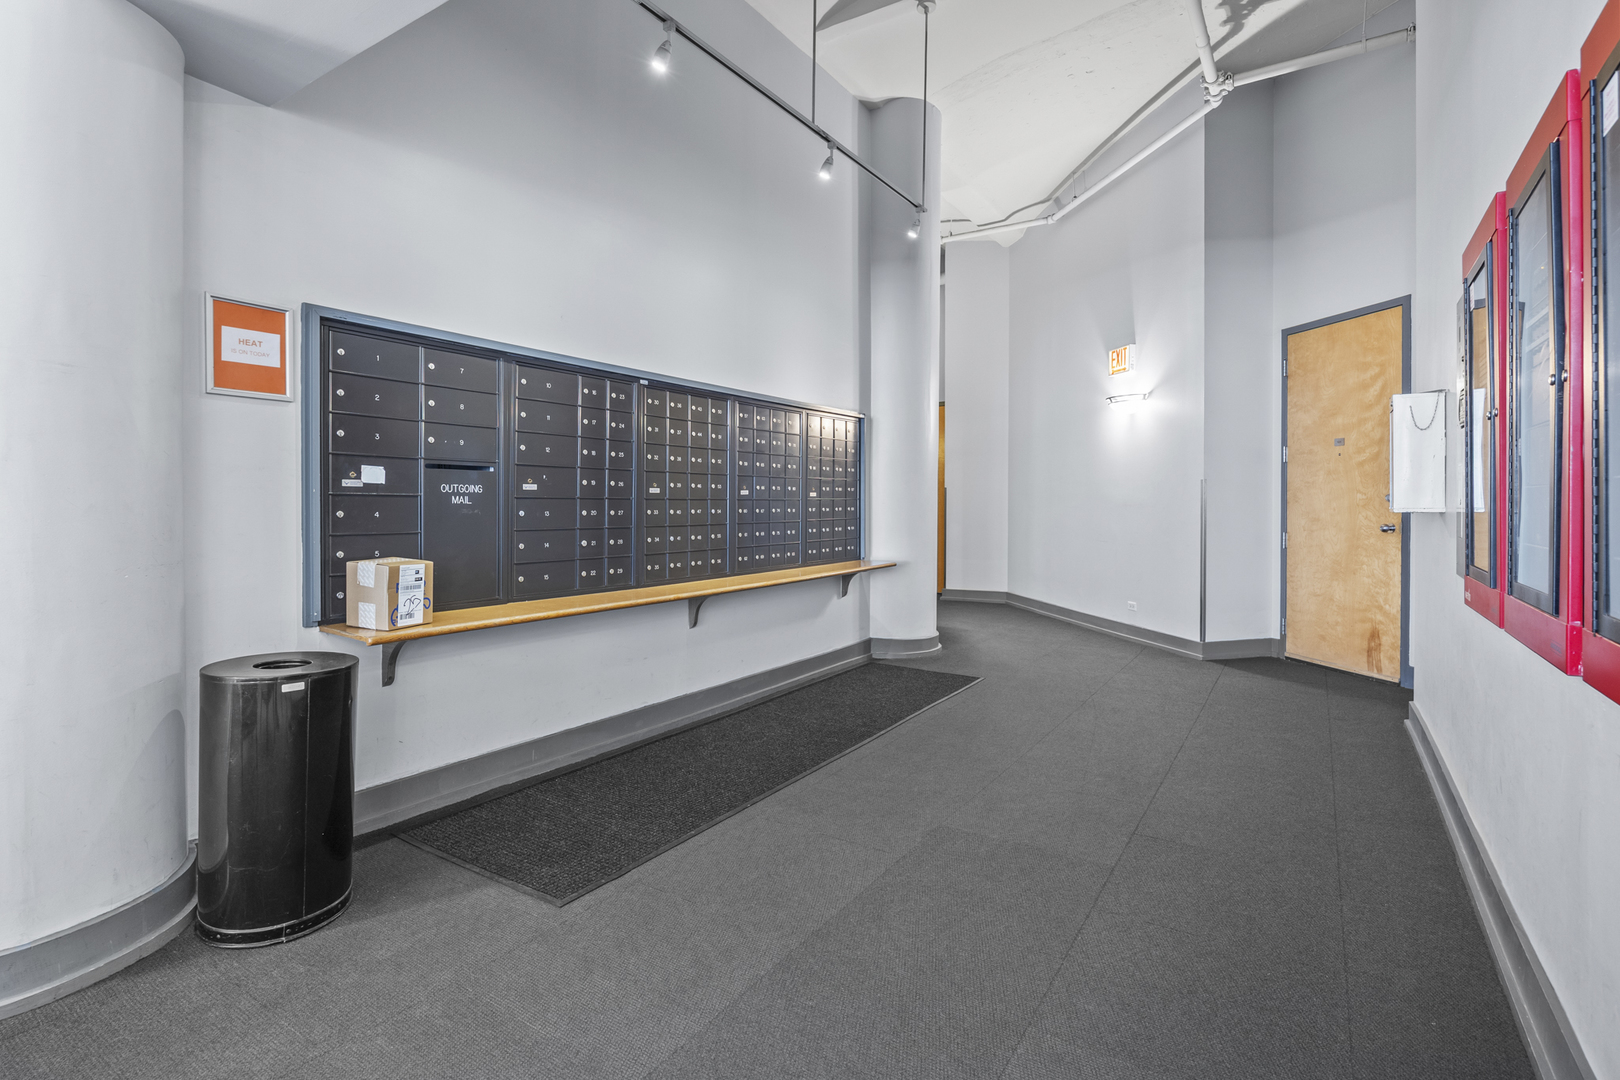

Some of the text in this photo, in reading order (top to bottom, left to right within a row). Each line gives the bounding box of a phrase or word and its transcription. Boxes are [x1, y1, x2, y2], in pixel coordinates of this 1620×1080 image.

[238, 338, 263, 347] HEAT
[1111, 347, 1127, 369] EXIT
[440, 484, 483, 493] OUTGOING
[451, 496, 472, 504] MAIL
